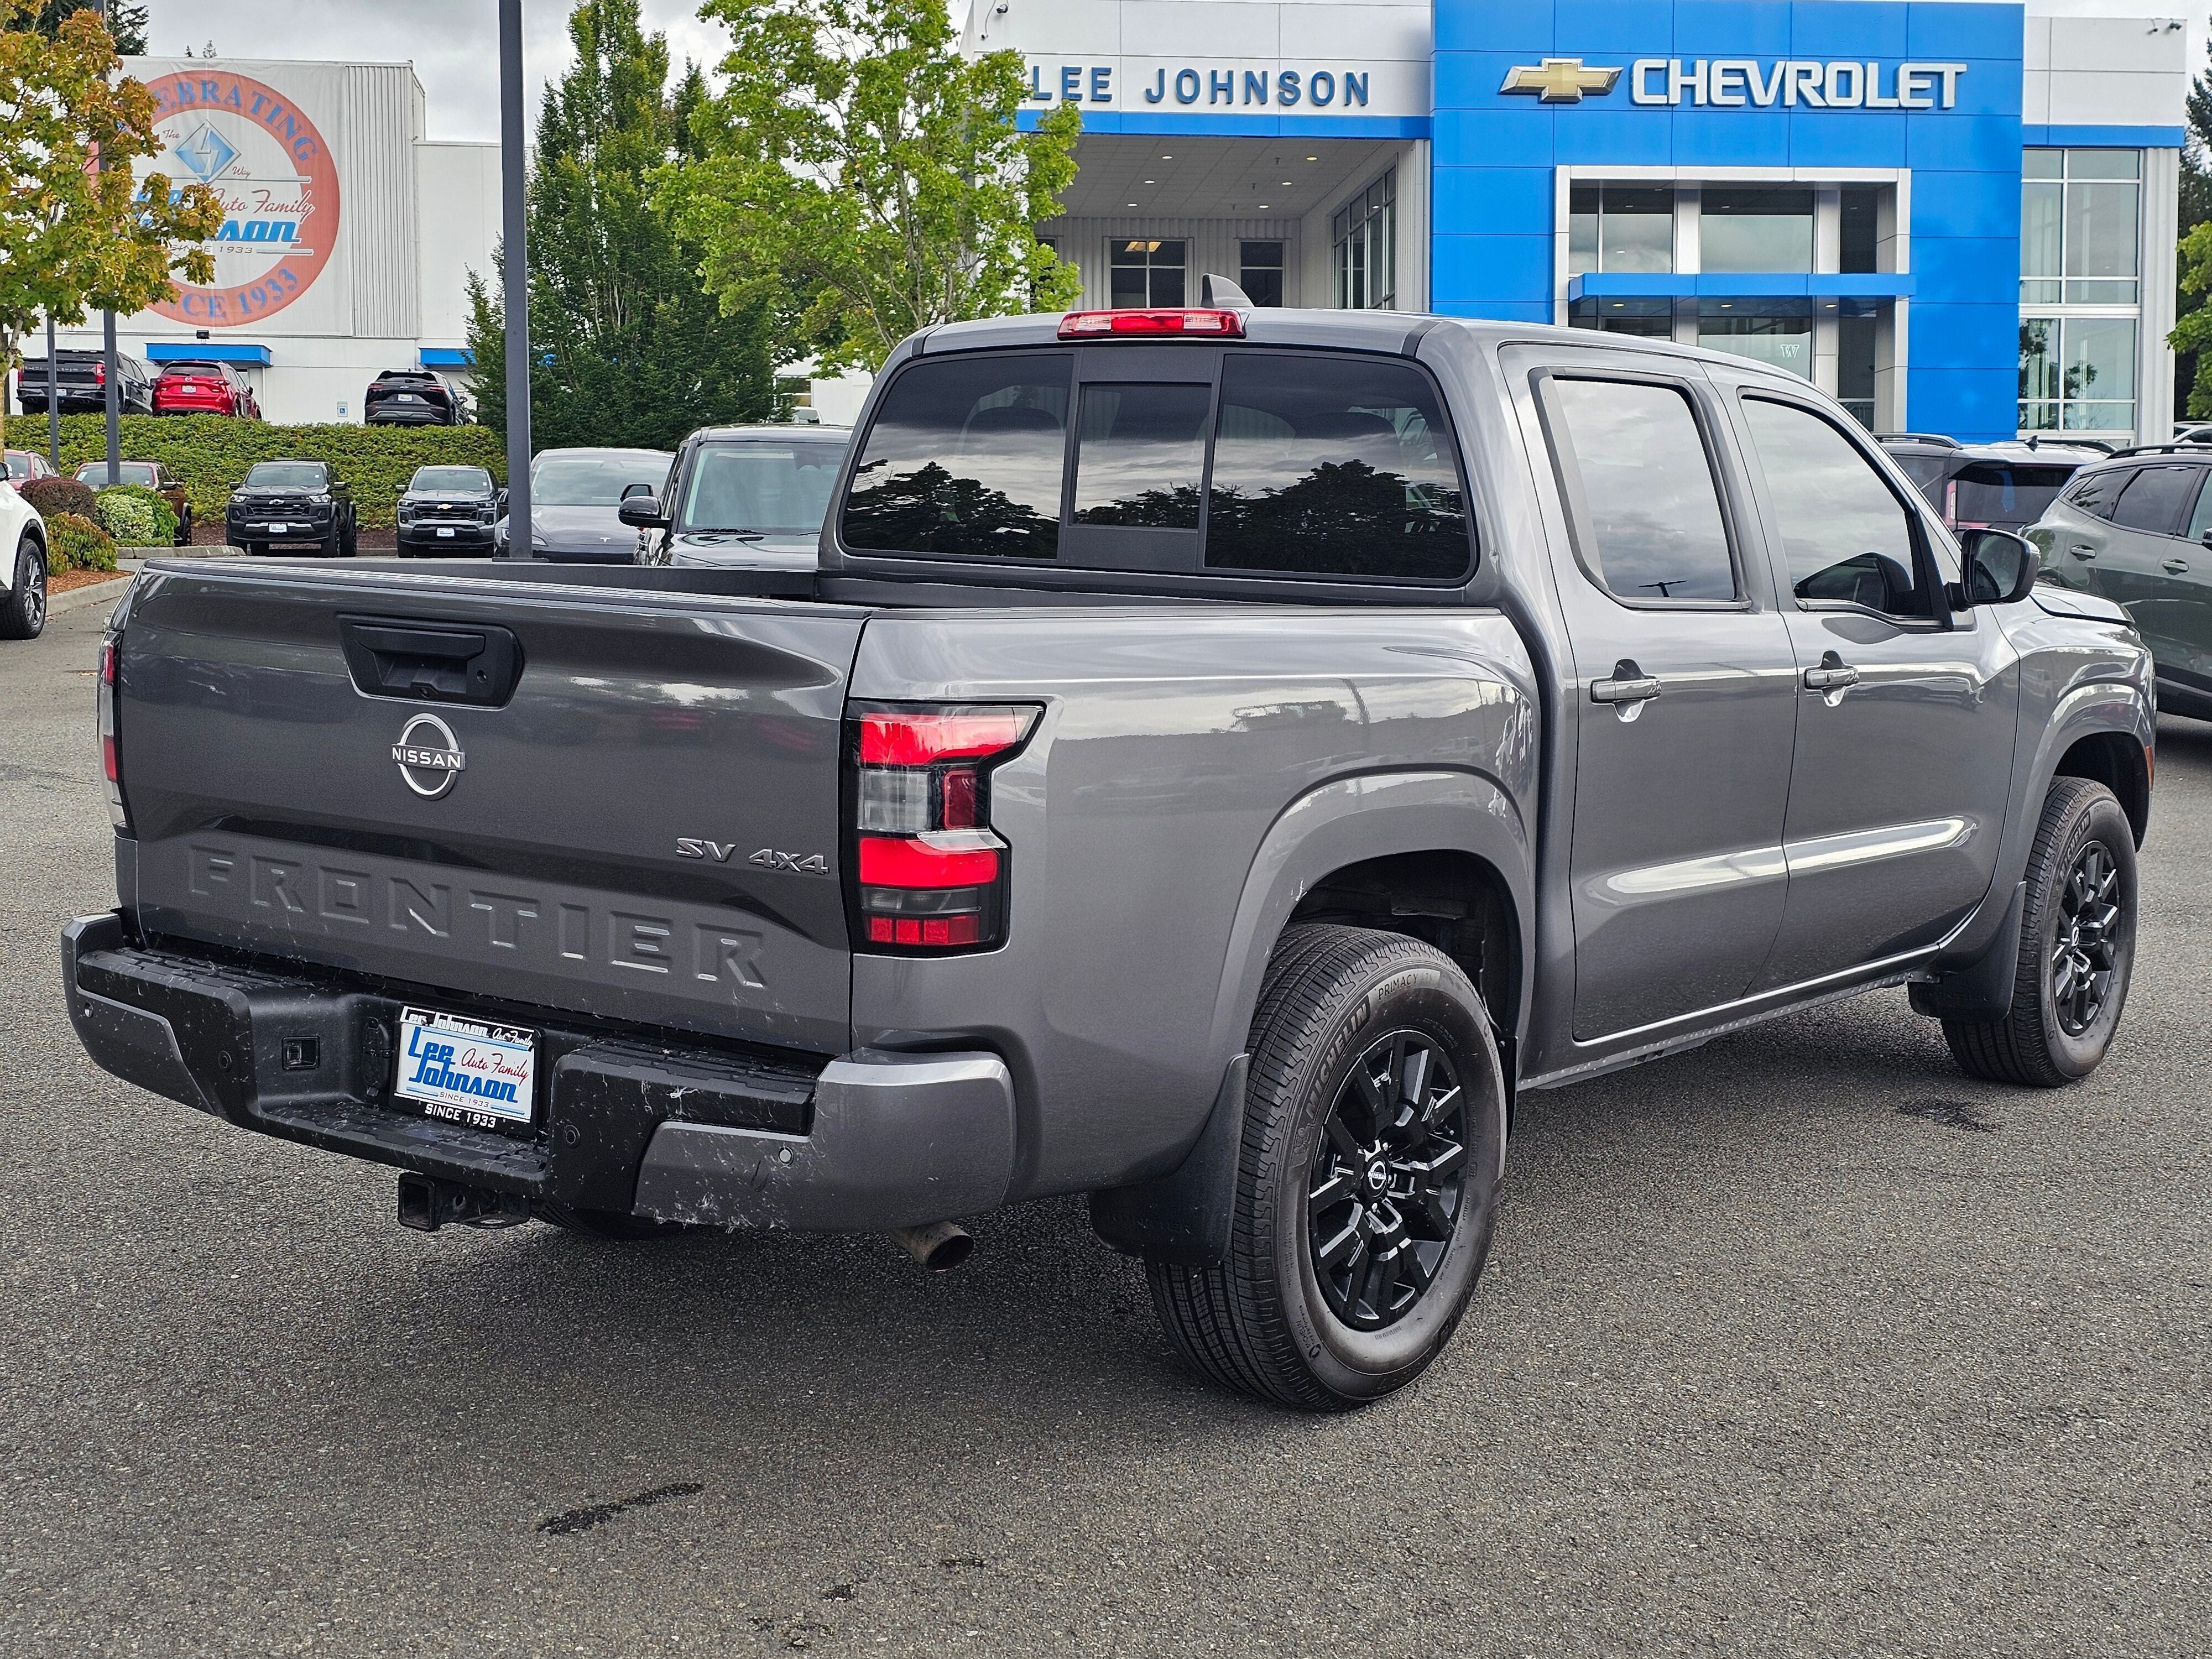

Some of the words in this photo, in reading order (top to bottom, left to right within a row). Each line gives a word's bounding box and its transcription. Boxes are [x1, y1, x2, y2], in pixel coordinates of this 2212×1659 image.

[1032, 65, 1113, 102] LEE
[1145, 67, 1369, 106] JOHNSON
[1630, 58, 1968, 108] CHEVROLET
[153, 80, 319, 160] EBRATING
[163, 129, 180, 139] The
[232, 166, 251, 179] Way
[251, 189, 314, 222] Family
[237, 268, 298, 315] 1933
[392, 747, 461, 769] NISSAN
[676, 837, 736, 862] SV
[2060, 814, 2090, 881] MICHELIN
[190, 844, 765, 989] FRONTIER
[429, 1011, 489, 1038] Johnson
[510, 1030, 533, 1051] Family
[1305, 1002, 1368, 1120] MICHELIN
[1378, 973, 1419, 1000] PRIMACY
[408, 1026, 455, 1060] Lee
[461, 1048, 489, 1072] Auto
[491, 1053, 529, 1086] Family
[409, 1053, 518, 1103] Johnson
[425, 1103, 462, 1121] SINCE
[467, 1112, 497, 1128] 1933
[439, 1092, 465, 1103] SINCE
[468, 1098, 489, 1108] 1933
